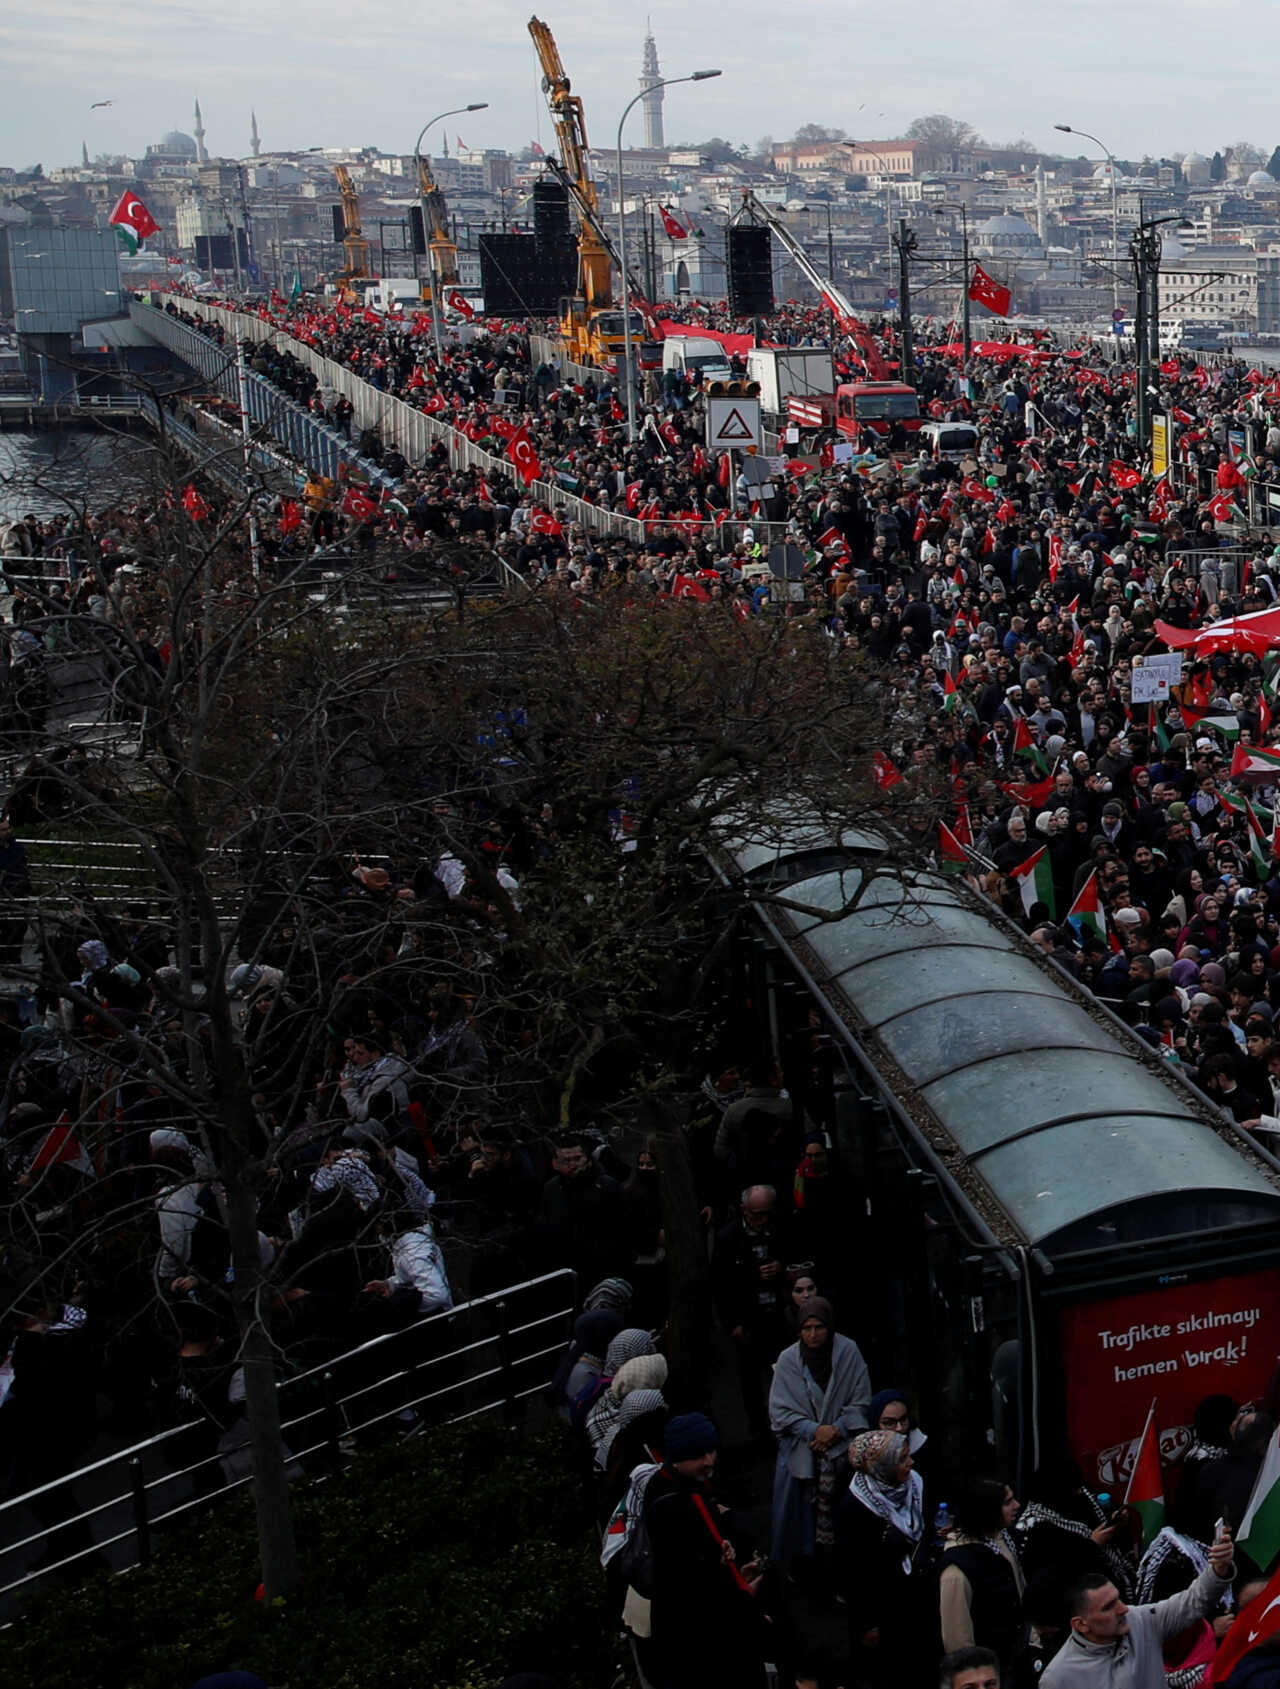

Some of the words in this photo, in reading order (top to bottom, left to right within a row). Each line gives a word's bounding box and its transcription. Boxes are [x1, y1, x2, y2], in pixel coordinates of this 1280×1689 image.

[1098, 1324, 1171, 1351] Trafikte
[1176, 1308, 1260, 1335] sıkılmayı
[1114, 1359, 1178, 1382] hemen
[1184, 1336, 1248, 1368] bırak!
